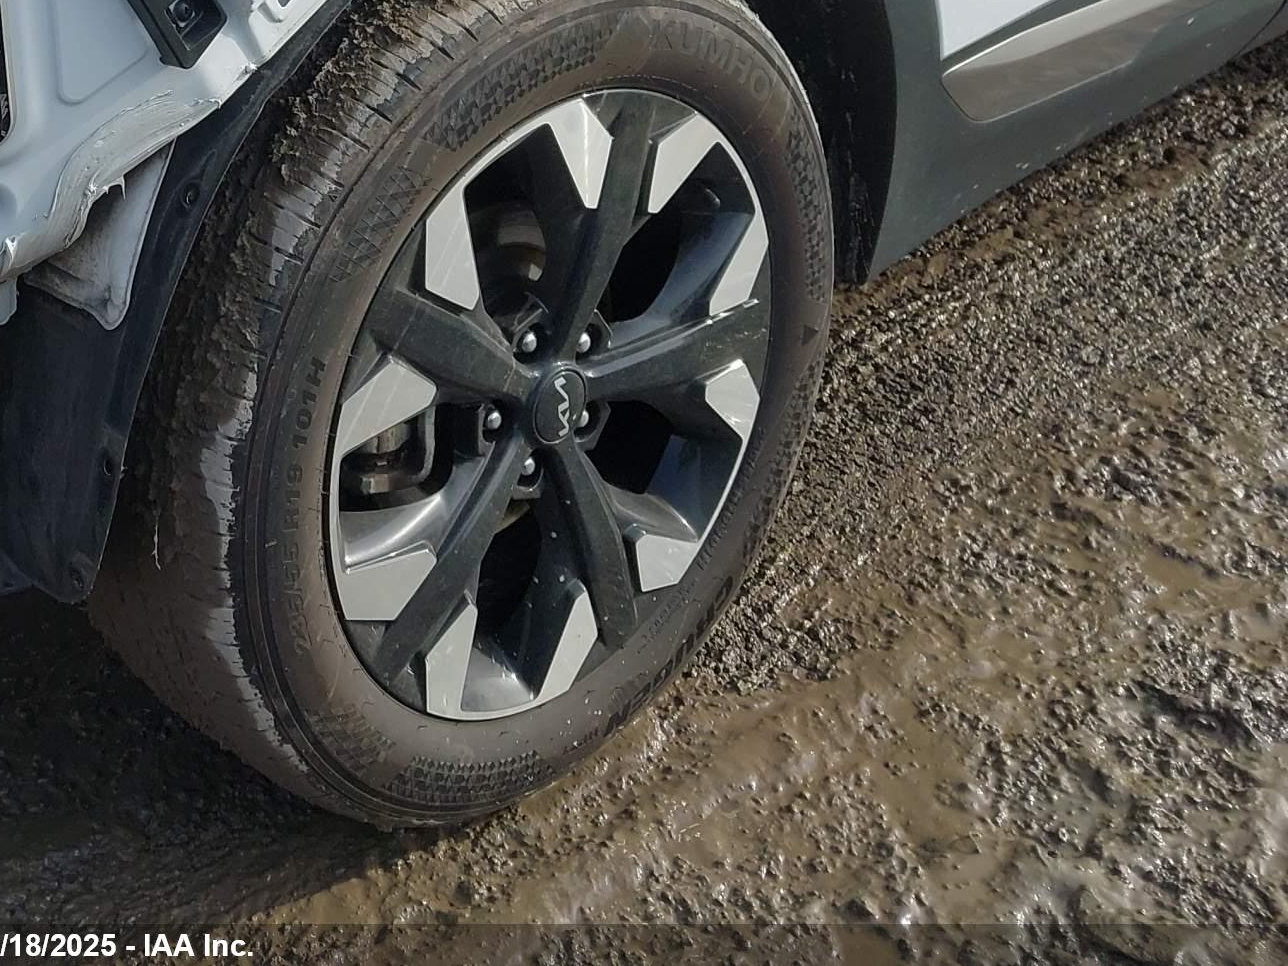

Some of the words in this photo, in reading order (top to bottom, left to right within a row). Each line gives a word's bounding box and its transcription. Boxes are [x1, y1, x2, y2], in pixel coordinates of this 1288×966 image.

[648, 18, 772, 100] KUMHO
[292, 356, 327, 449] 101H
[283, 464, 303, 532] R19
